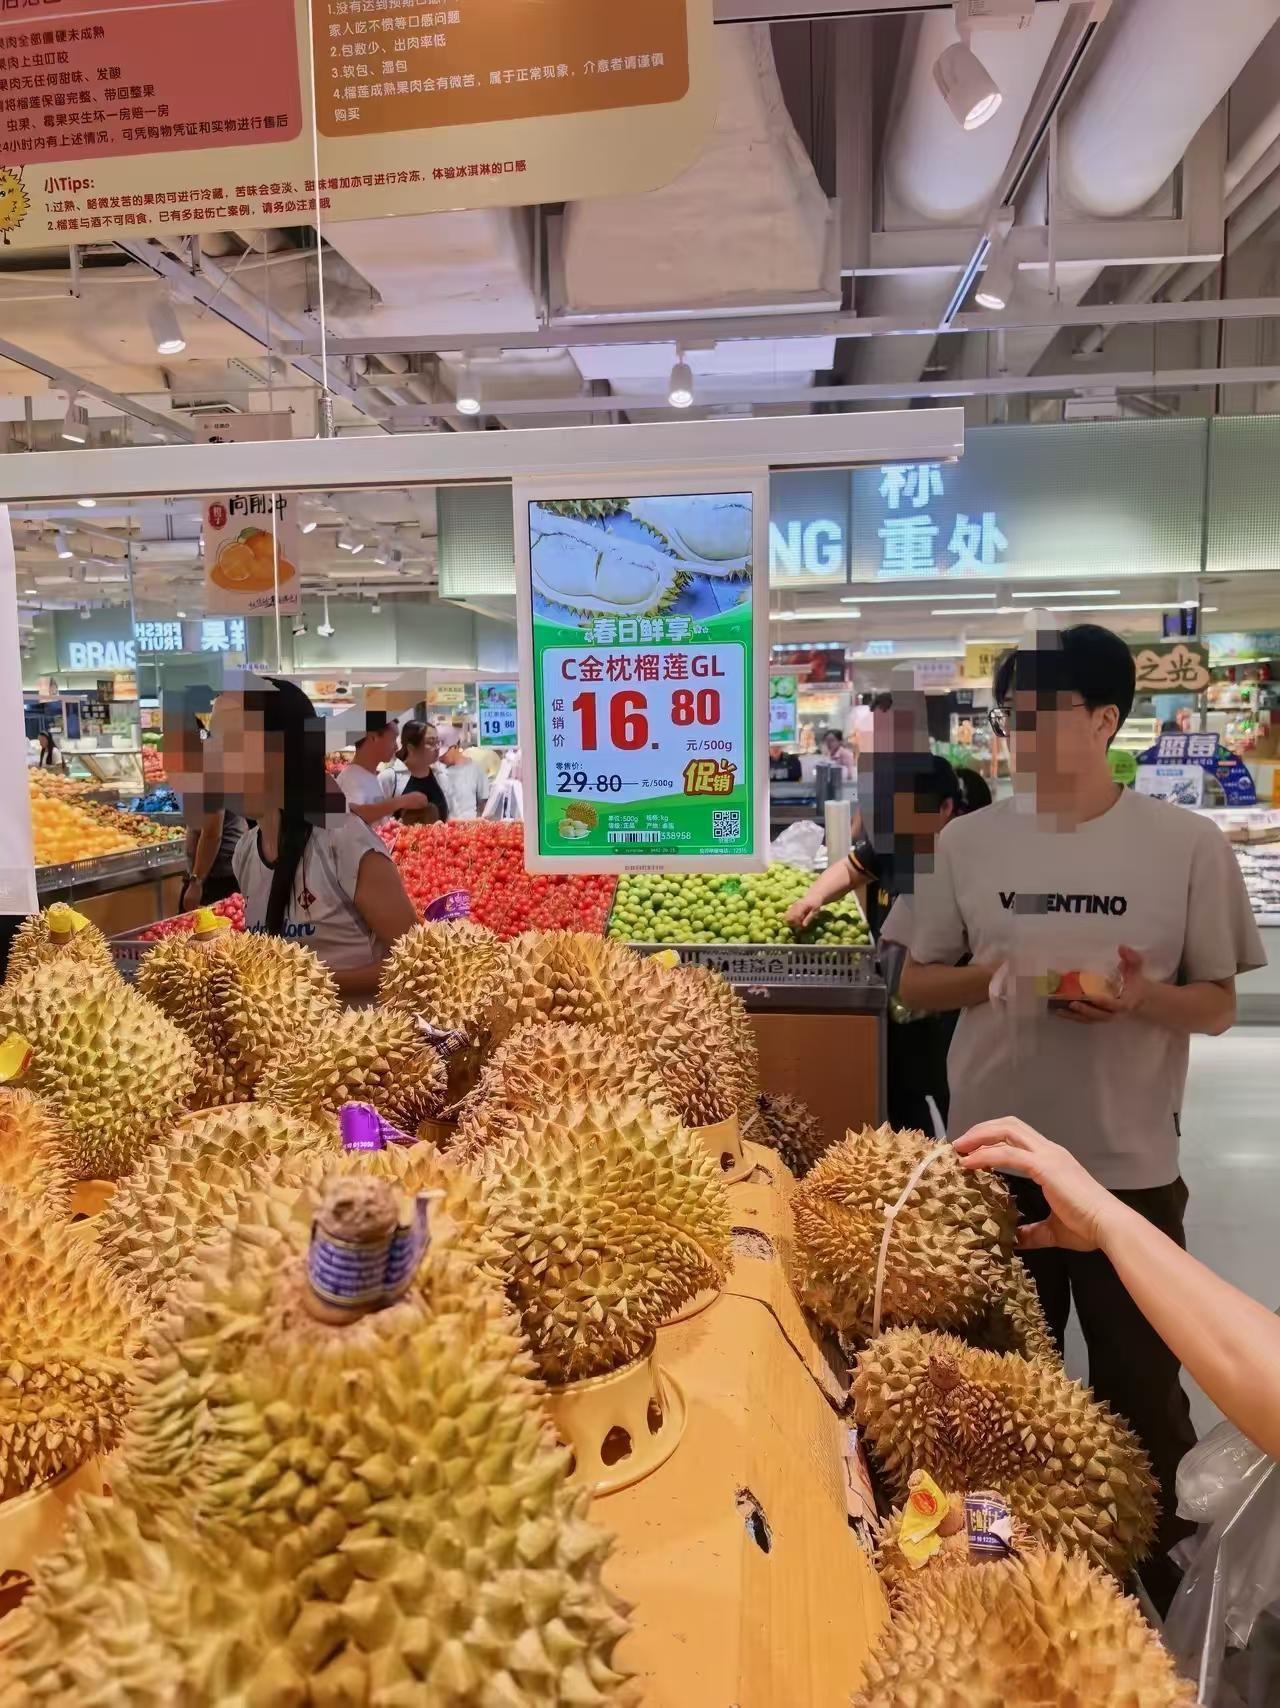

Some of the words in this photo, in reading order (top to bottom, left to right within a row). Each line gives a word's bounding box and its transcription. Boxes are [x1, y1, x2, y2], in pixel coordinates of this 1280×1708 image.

[328, 10, 461, 38] 家人吃不惯等口感问题
[330, 33, 447, 58] 2.包数少、出肉率低
[331, 60, 408, 79] 3.软包、湿包
[334, 106, 361, 122] 购买
[877, 511, 1009, 578] 重处
[592, 616, 692, 644] 春日鲜享
[561, 653, 726, 683] C金枕榴莲GL
[1137, 653, 1199, 683] 之光
[552, 697, 565, 748] 促销价
[685, 738, 733, 752] 元/500g
[557, 771, 623, 793] 29.80
[641, 779, 674, 789] 元/500g
[998, 891, 1128, 917] VENTINO
